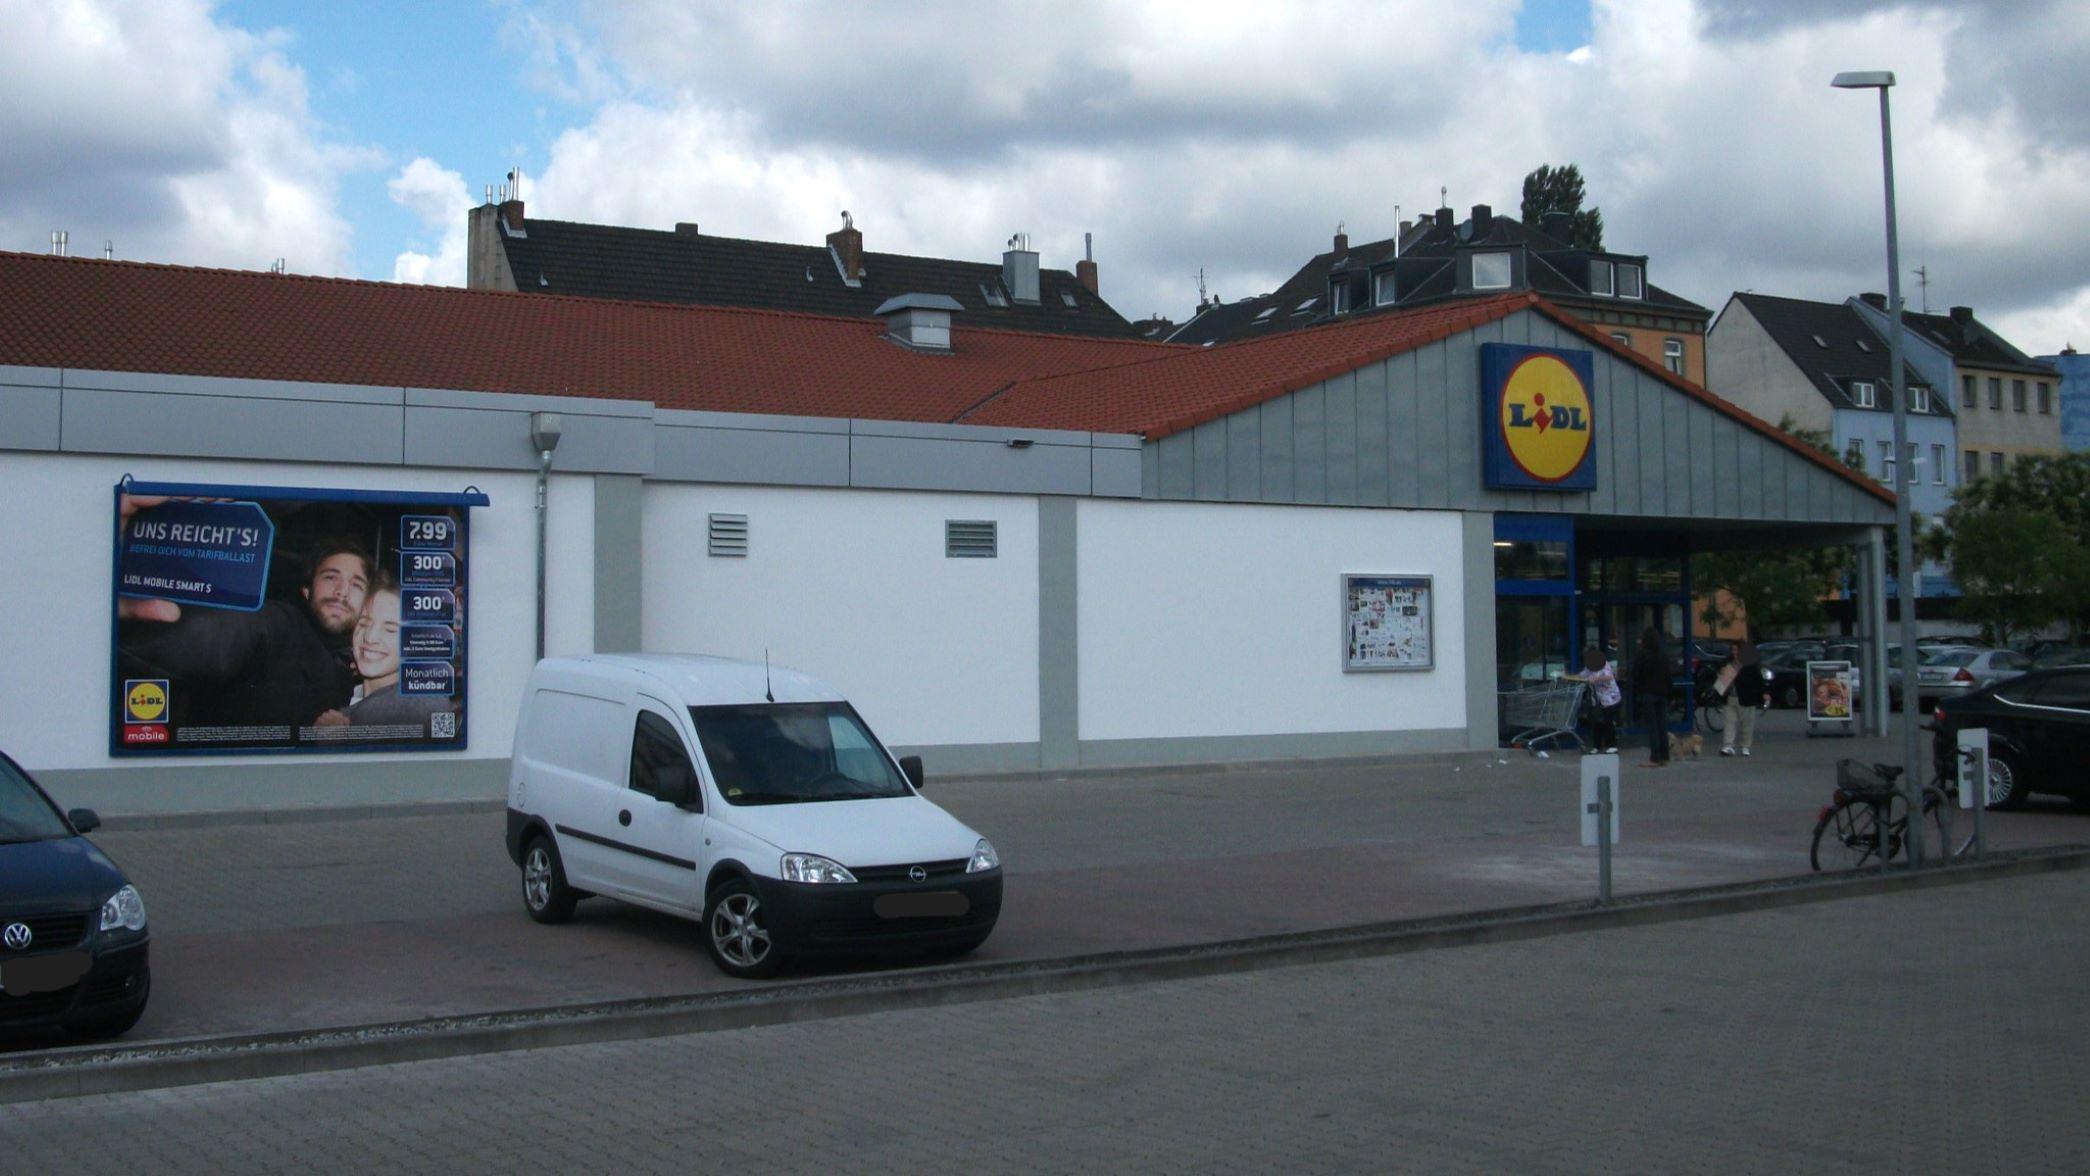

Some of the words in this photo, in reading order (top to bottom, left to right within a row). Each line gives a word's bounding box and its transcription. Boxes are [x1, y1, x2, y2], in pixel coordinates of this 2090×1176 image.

[133, 521, 167, 540] UNS
[170, 523, 259, 547] REICHT'S!
[157, 545, 177, 556] DICH
[196, 549, 255, 563] TARIFBALLAST
[413, 555, 442, 570] 300
[124, 574, 142, 585] LIDL
[143, 576, 174, 590] MOBILE
[175, 580, 204, 593] SMART
[205, 584, 212, 593] S
[412, 596, 442, 610] 300
[405, 668, 449, 679] Monatlich
[408, 680, 446, 690] kündbar
[128, 731, 165, 740] mobile
